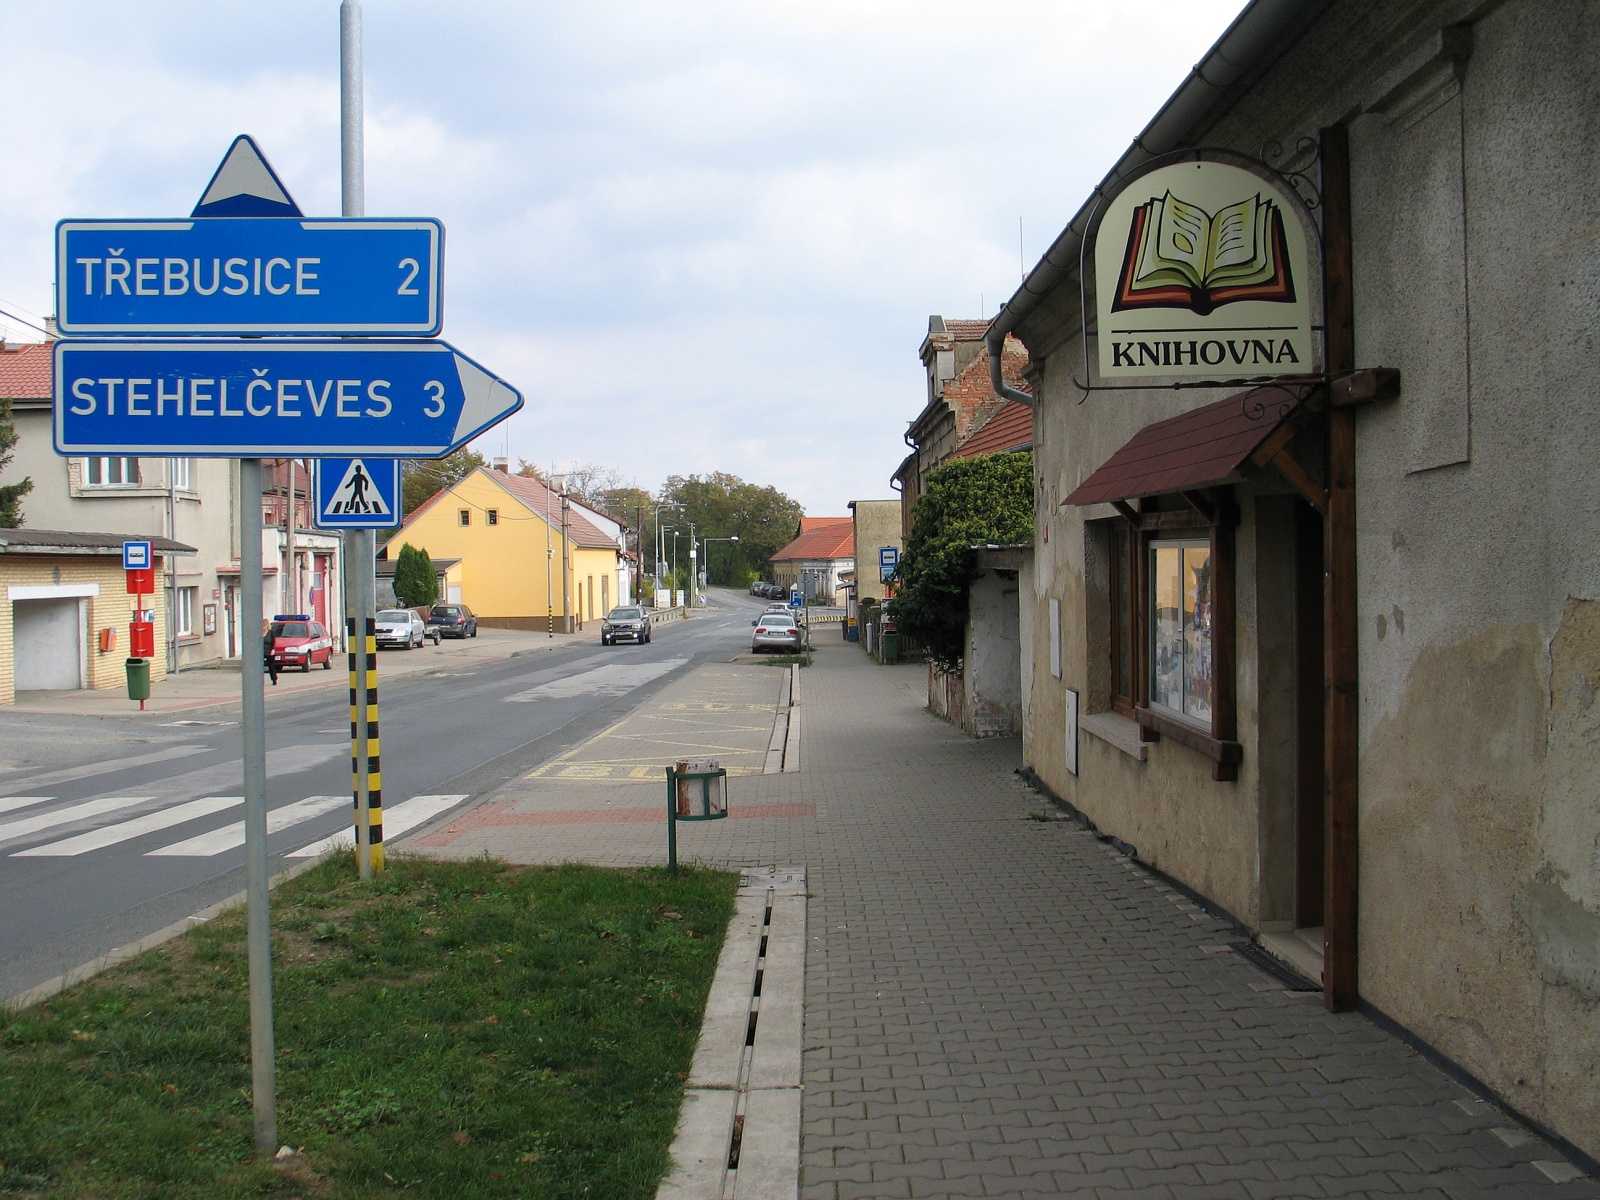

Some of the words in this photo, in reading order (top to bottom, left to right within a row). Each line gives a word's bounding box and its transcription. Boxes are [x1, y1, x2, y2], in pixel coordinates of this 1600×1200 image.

[76, 248, 321, 296] TŘEBUSICE
[397, 257, 420, 296] 2
[1112, 338, 1300, 367] KNIHOVNA
[70, 368, 392, 418] STEHELČEVES
[423, 380, 446, 418] 3
